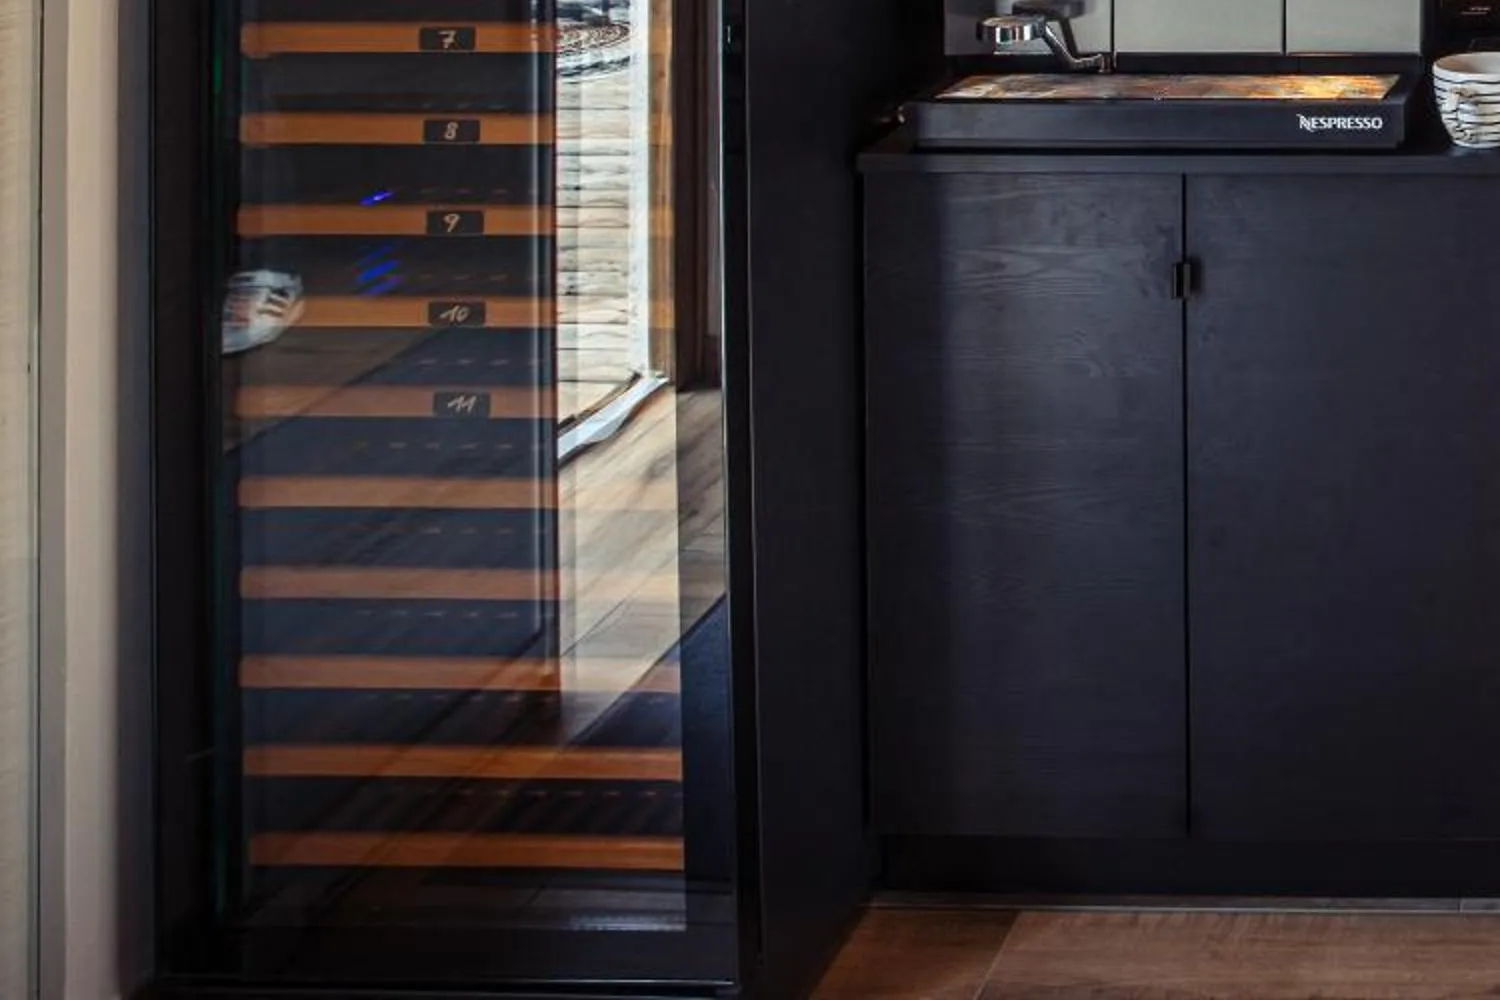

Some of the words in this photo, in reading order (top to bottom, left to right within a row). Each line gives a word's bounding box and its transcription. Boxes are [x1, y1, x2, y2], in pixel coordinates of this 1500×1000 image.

[437, 30, 456, 49] 7
[444, 122, 458, 141] 8
[1296, 114, 1383, 132] NESPRESSO
[443, 213, 460, 233] 9
[439, 304, 470, 323] 10
[447, 395, 477, 413] 11
